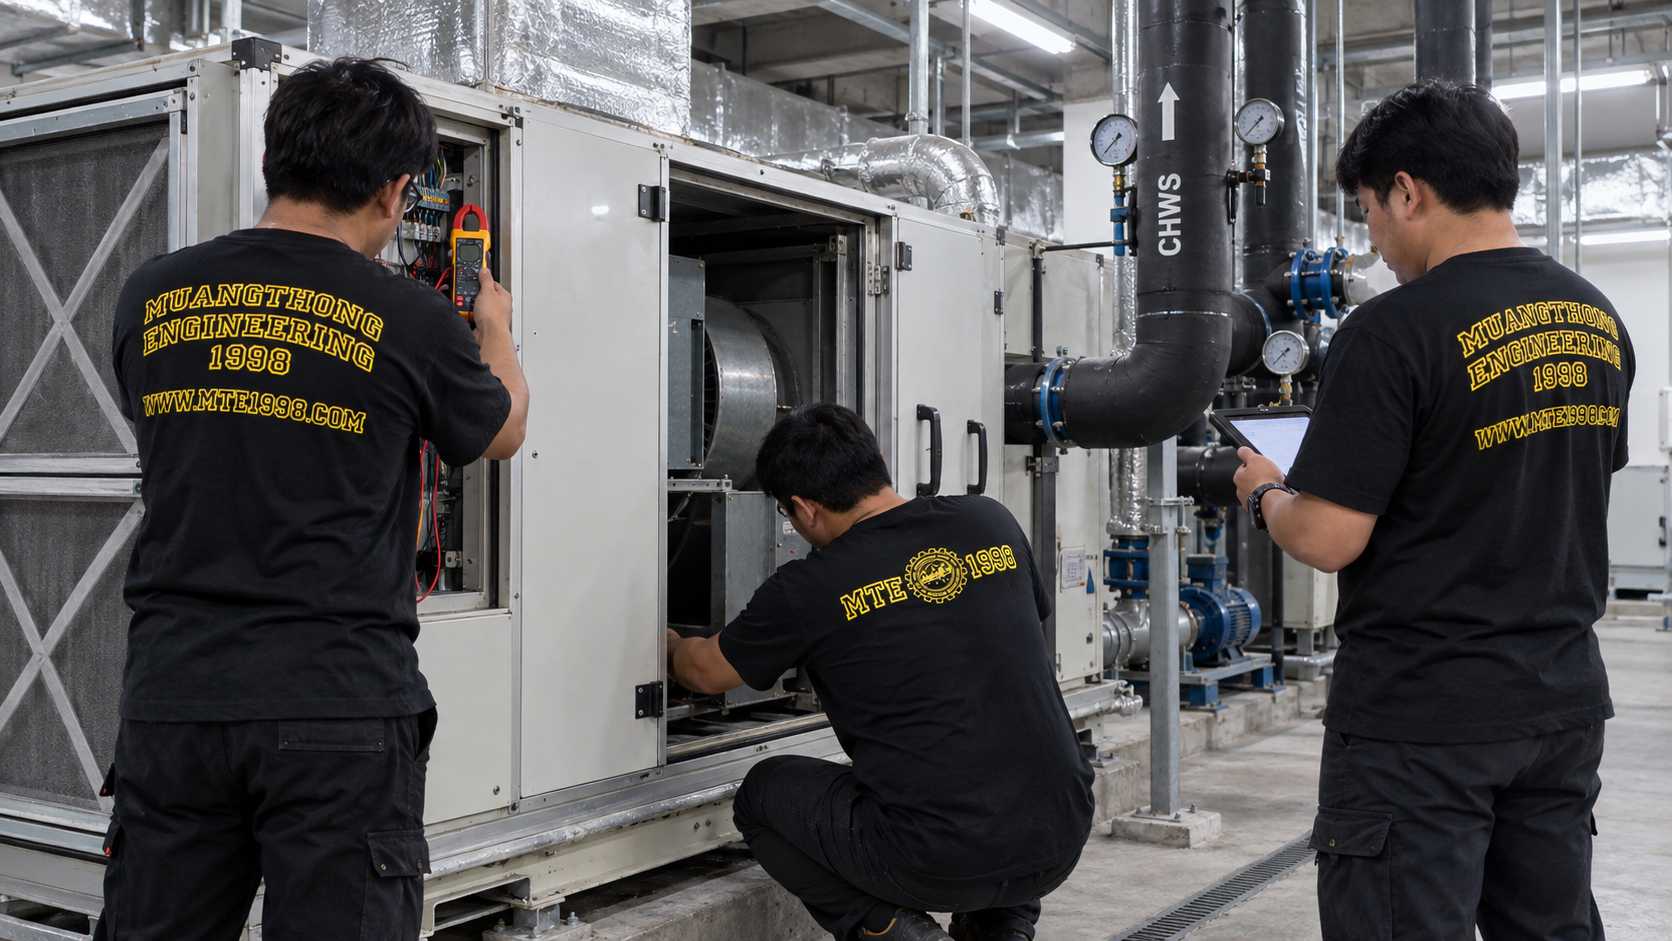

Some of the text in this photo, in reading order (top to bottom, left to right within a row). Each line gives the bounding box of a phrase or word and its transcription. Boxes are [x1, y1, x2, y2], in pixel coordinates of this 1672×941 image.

[1157, 173, 1182, 257] CHWS
[142, 312, 376, 373] ENGINEERING
[143, 283, 384, 343] MUANGTHONG
[1456, 300, 1619, 359] MUANGTHONG
[208, 343, 292, 376] 1998
[1466, 329, 1622, 392] ENGINEERING
[1532, 361, 1589, 393] 1998
[142, 387, 367, 434] WWW.MTE1998.COM
[839, 575, 909, 622] MTE
[964, 544, 1018, 580] 1998
